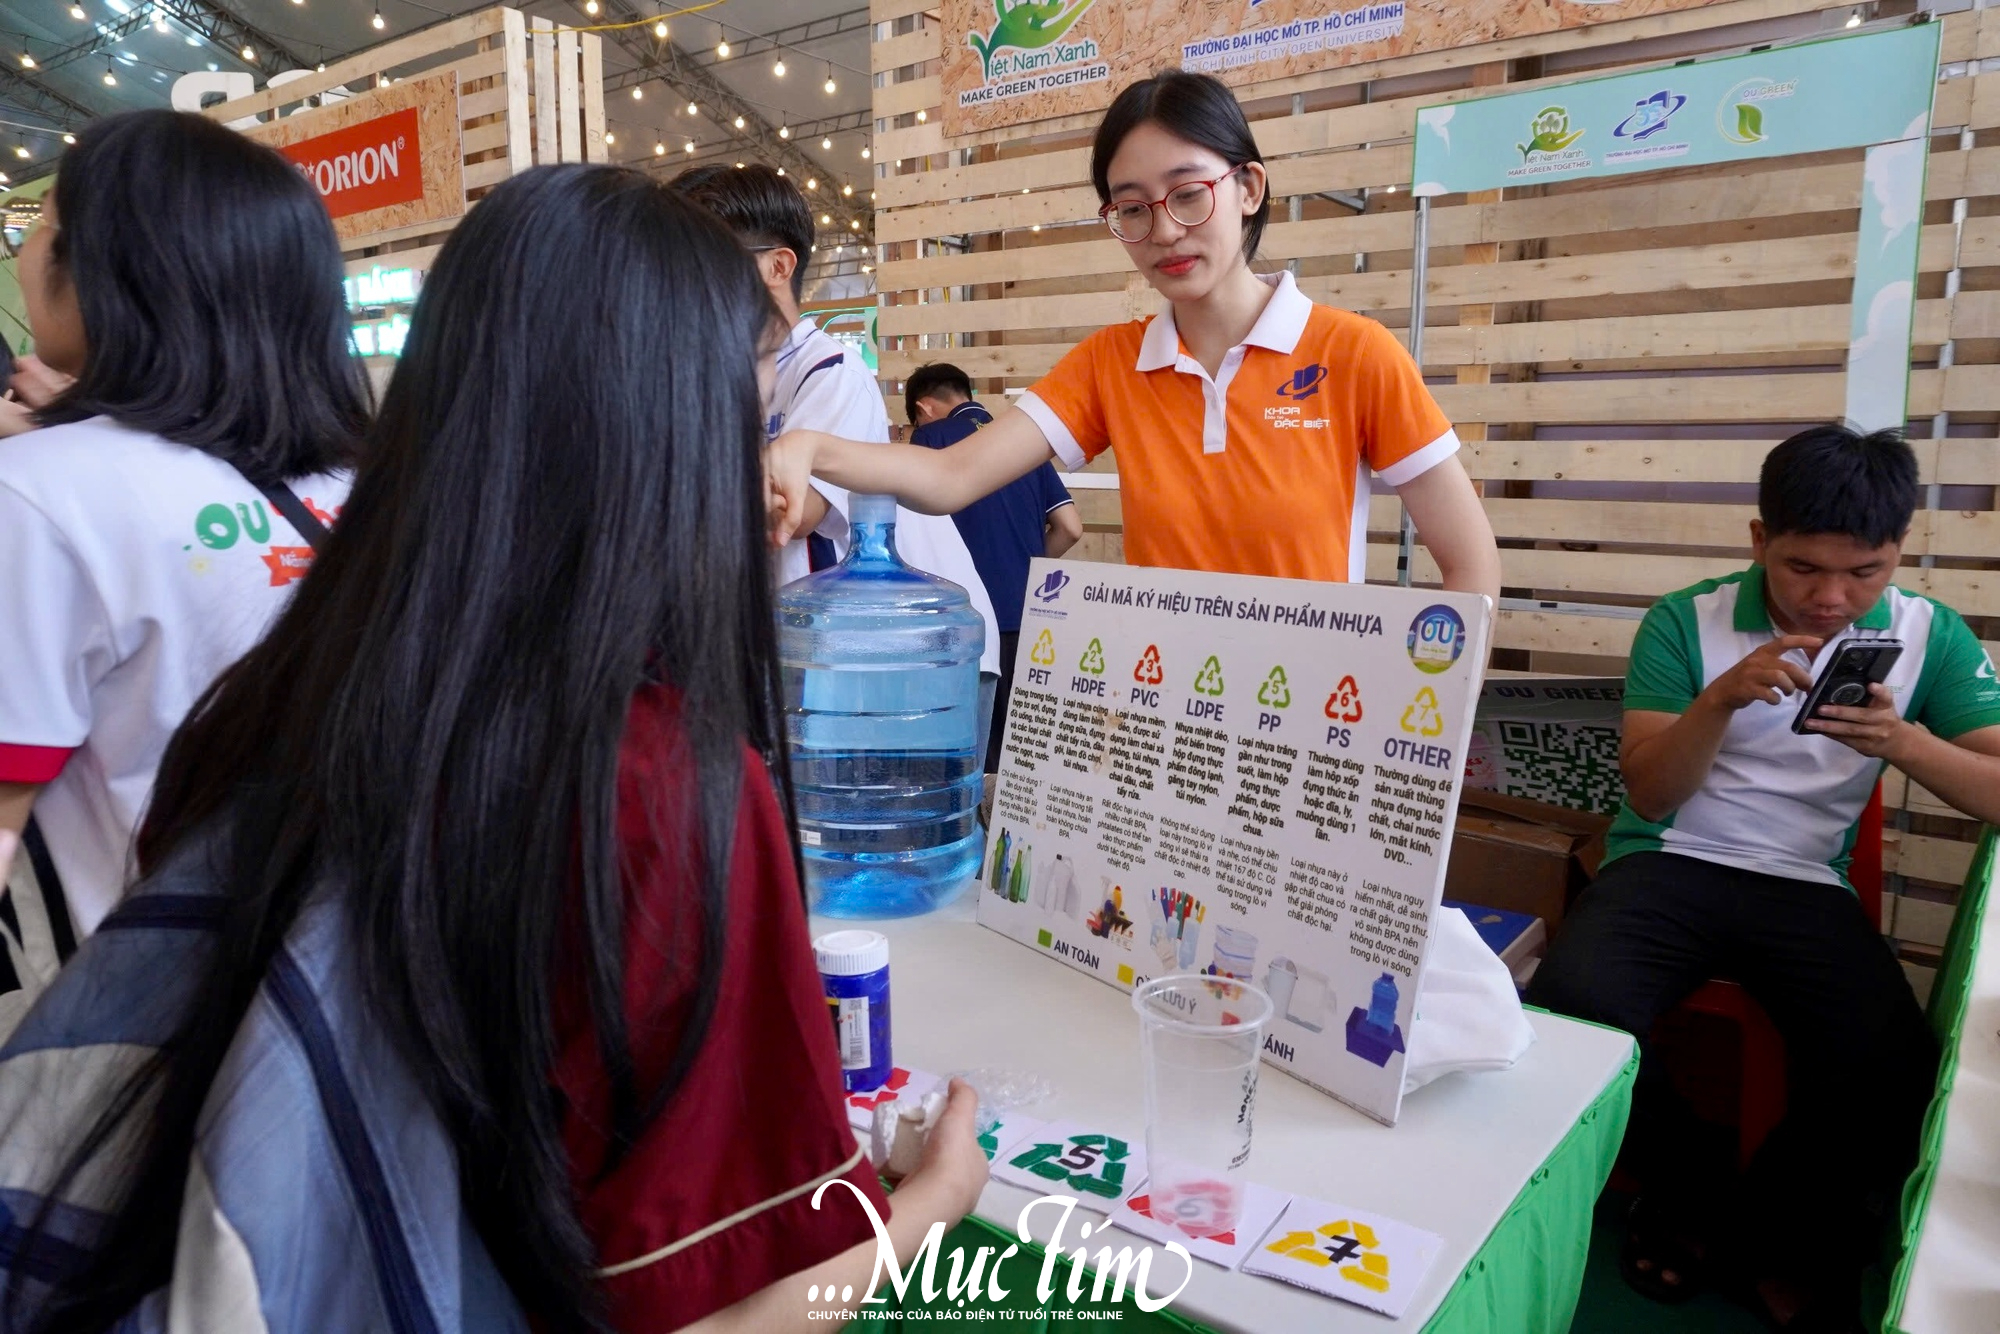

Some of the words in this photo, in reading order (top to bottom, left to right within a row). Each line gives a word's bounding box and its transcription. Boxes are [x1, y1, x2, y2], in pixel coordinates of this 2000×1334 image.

[1184, 38, 1229, 59] TRƯỜNG
[1232, 34, 1251, 51] ĐẠI
[1254, 29, 1279, 48] HỌC
[1281, 21, 1301, 39] MỞ
[1304, 21, 1320, 36] TP.
[1324, 13, 1342, 31] HỒ
[1344, 9, 1366, 27] CHÍ
[1369, 4, 1403, 22] MINH
[1013, 50, 1051, 72] Nam
[1055, 40, 1097, 64] Xanh
[961, 88, 994, 105] MAKE
[996, 79, 1036, 97] GREEN
[1040, 65, 1107, 88] TOGETHER
[1508, 168, 1528, 177] MAKE
[1528, 165, 1552, 174] GREEN
[1553, 160, 1591, 171] TOGETHER
[1264, 406, 1301, 420] KHOA
[1274, 418, 1300, 430] ĐẶC
[1303, 417, 1331, 430] BIỆT
[195, 499, 271, 550] OU
[1083, 582, 1110, 603] GIẢI
[1111, 586, 1133, 606] MÃ
[1136, 589, 1156, 608] KÝ
[1157, 591, 1192, 615] HIỆU
[1195, 595, 1234, 618] TRÊN
[1237, 598, 1271, 622] SẢN
[1274, 603, 1326, 629] PHẨM
[1329, 612, 1383, 638] NHỰA
[1087, 650, 1097, 664] 2
[1147, 659, 1156, 673] 3
[1028, 668, 1052, 686] PET
[1208, 670, 1216, 682] 4
[1072, 677, 1106, 698] HDPE
[1131, 688, 1160, 708] PVC
[1273, 681, 1282, 694] 5
[1186, 699, 1225, 722] LDPE
[1340, 692, 1352, 708] 6
[1259, 713, 1281, 733] PP
[1421, 705, 1431, 720] 7
[1237, 735, 1254, 749] Loại
[1255, 740, 1276, 753] nhựa
[1327, 726, 1351, 748] PS
[1254, 754, 1270, 766] như
[1271, 758, 1293, 774] trong
[1308, 751, 1341, 770] Thường
[1342, 758, 1365, 775] dùng
[1384, 738, 1452, 770] OTHER
[1237, 765, 1256, 779] suốt,
[1257, 768, 1273, 781] làm
[1273, 772, 1289, 787] hộp
[1307, 765, 1324, 779] làm
[1343, 775, 1360, 789] xốp
[1374, 765, 1410, 786] Thường
[1411, 774, 1437, 792] dùng
[1240, 779, 1261, 795] đựng
[1262, 784, 1281, 798] thực
[1303, 780, 1326, 797] đựng
[1327, 786, 1347, 800] thức
[1348, 790, 1360, 803] ăn
[1375, 782, 1392, 795] sản
[1393, 788, 1415, 801] xuất
[1417, 791, 1446, 810] thùng
[1304, 794, 1325, 810] hoặc
[1343, 805, 1353, 819] ly,
[1371, 797, 1395, 812] nhựa
[1397, 803, 1423, 821] đựng
[1424, 809, 1444, 824] hóa
[1253, 810, 1268, 826] hộp
[1327, 816, 1349, 834] dùng
[1352, 823, 1356, 834] 1
[1369, 812, 1391, 829] chất,
[1393, 819, 1414, 833] chai
[1415, 826, 1441, 840] nước
[1243, 823, 1264, 838] chua.
[1370, 828, 1387, 844] lớn,
[1410, 838, 1433, 857] kính,
[1384, 848, 1412, 866] DVD...
[1054, 940, 1069, 956] AN
[1072, 946, 1100, 970] TOÀN
[1057, 1145, 1103, 1170] 5
[1323, 1234, 1361, 1263] 7
